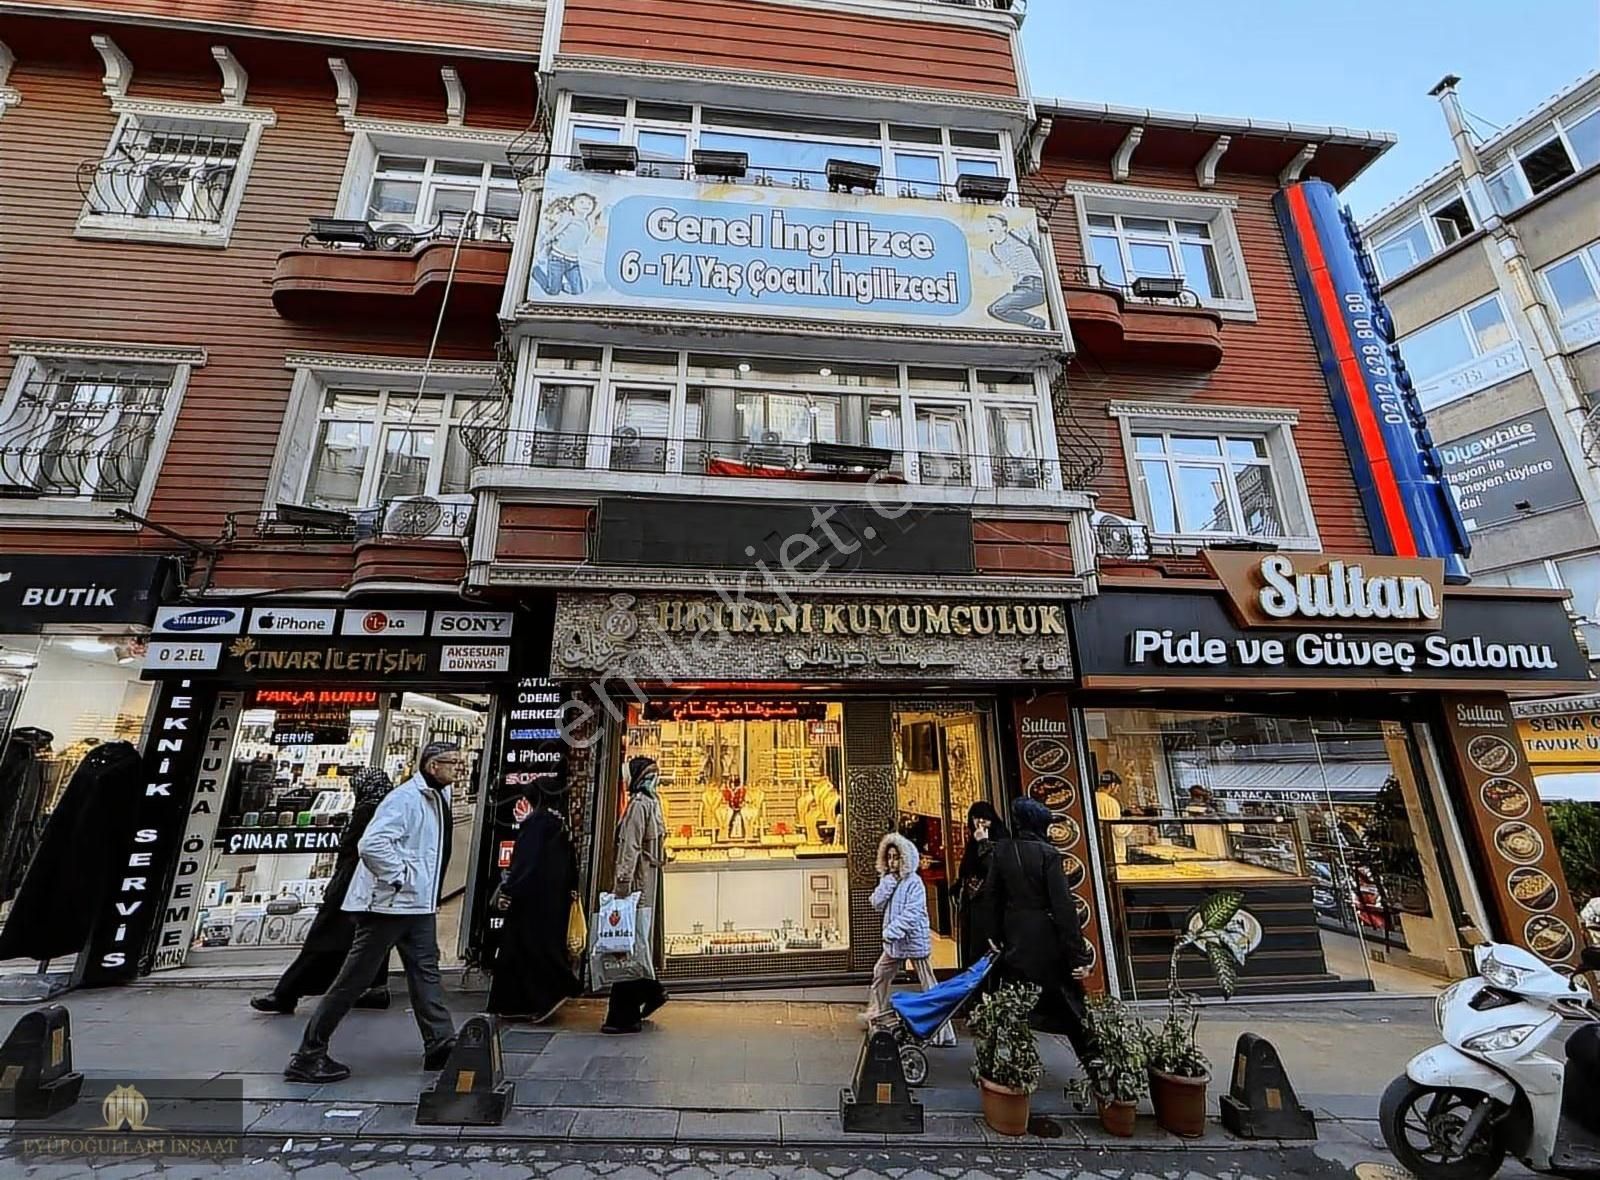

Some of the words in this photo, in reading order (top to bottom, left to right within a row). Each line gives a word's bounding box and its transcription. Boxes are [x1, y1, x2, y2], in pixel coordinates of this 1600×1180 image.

[646, 207, 764, 247] Genel
[770, 210, 936, 261] İngilizce
[619, 252, 639, 283] 6
[661, 253, 692, 287] 14
[695, 255, 743, 295] Yaş
[747, 260, 828, 298] Çocuk
[831, 259, 959, 304] İngilizcesi
[1345, 294, 1366, 313] 80
[1353, 319, 1375, 340] 80
[1361, 344, 1388, 377] 628
[1375, 384, 1403, 424] 0212
[1441, 421, 1535, 466] bluewhite
[1443, 466, 1487, 484] lasyon
[1504, 459, 1554, 483] tüylere
[21, 583, 118, 606] BUTİK
[1259, 555, 1441, 621] Sultan
[276, 615, 326, 631] iPhone
[389, 619, 405, 629] LG
[440, 616, 507, 632] SONY
[820, 604, 1065, 636] KUYUMCULUK
[173, 648, 206, 663] 2.EL
[447, 647, 506, 658] AKSESUAR
[1132, 627, 1229, 665] Pide
[1235, 639, 1285, 665] ve
[1294, 633, 1417, 674] Güveç
[1424, 636, 1559, 670] Salonu
[243, 650, 321, 673] ÇINAR
[323, 647, 427, 675] İLETİŞİM
[448, 658, 497, 670] DÜNYASI
[518, 692, 560, 703] ÖDEME
[1533, 700, 1585, 714] TAVUK
[511, 709, 564, 720] MERKEZİ
[1457, 704, 1505, 723] Sultan
[1021, 717, 1066, 733] Sultan
[1530, 716, 1586, 733] SENA
[274, 730, 314, 743] SERVİS
[1525, 738, 1583, 752] TAVUK
[190, 696, 236, 816] FATURA
[519, 750, 560, 763] iPhone
[1226, 790, 1272, 800] KARACA
[1280, 790, 1319, 801] HOME
[230, 833, 288, 853] ÇINAR
[294, 832, 340, 849] TEKN
[101, 828, 158, 968] SERVİS
[161, 834, 204, 948] ÖDEME
